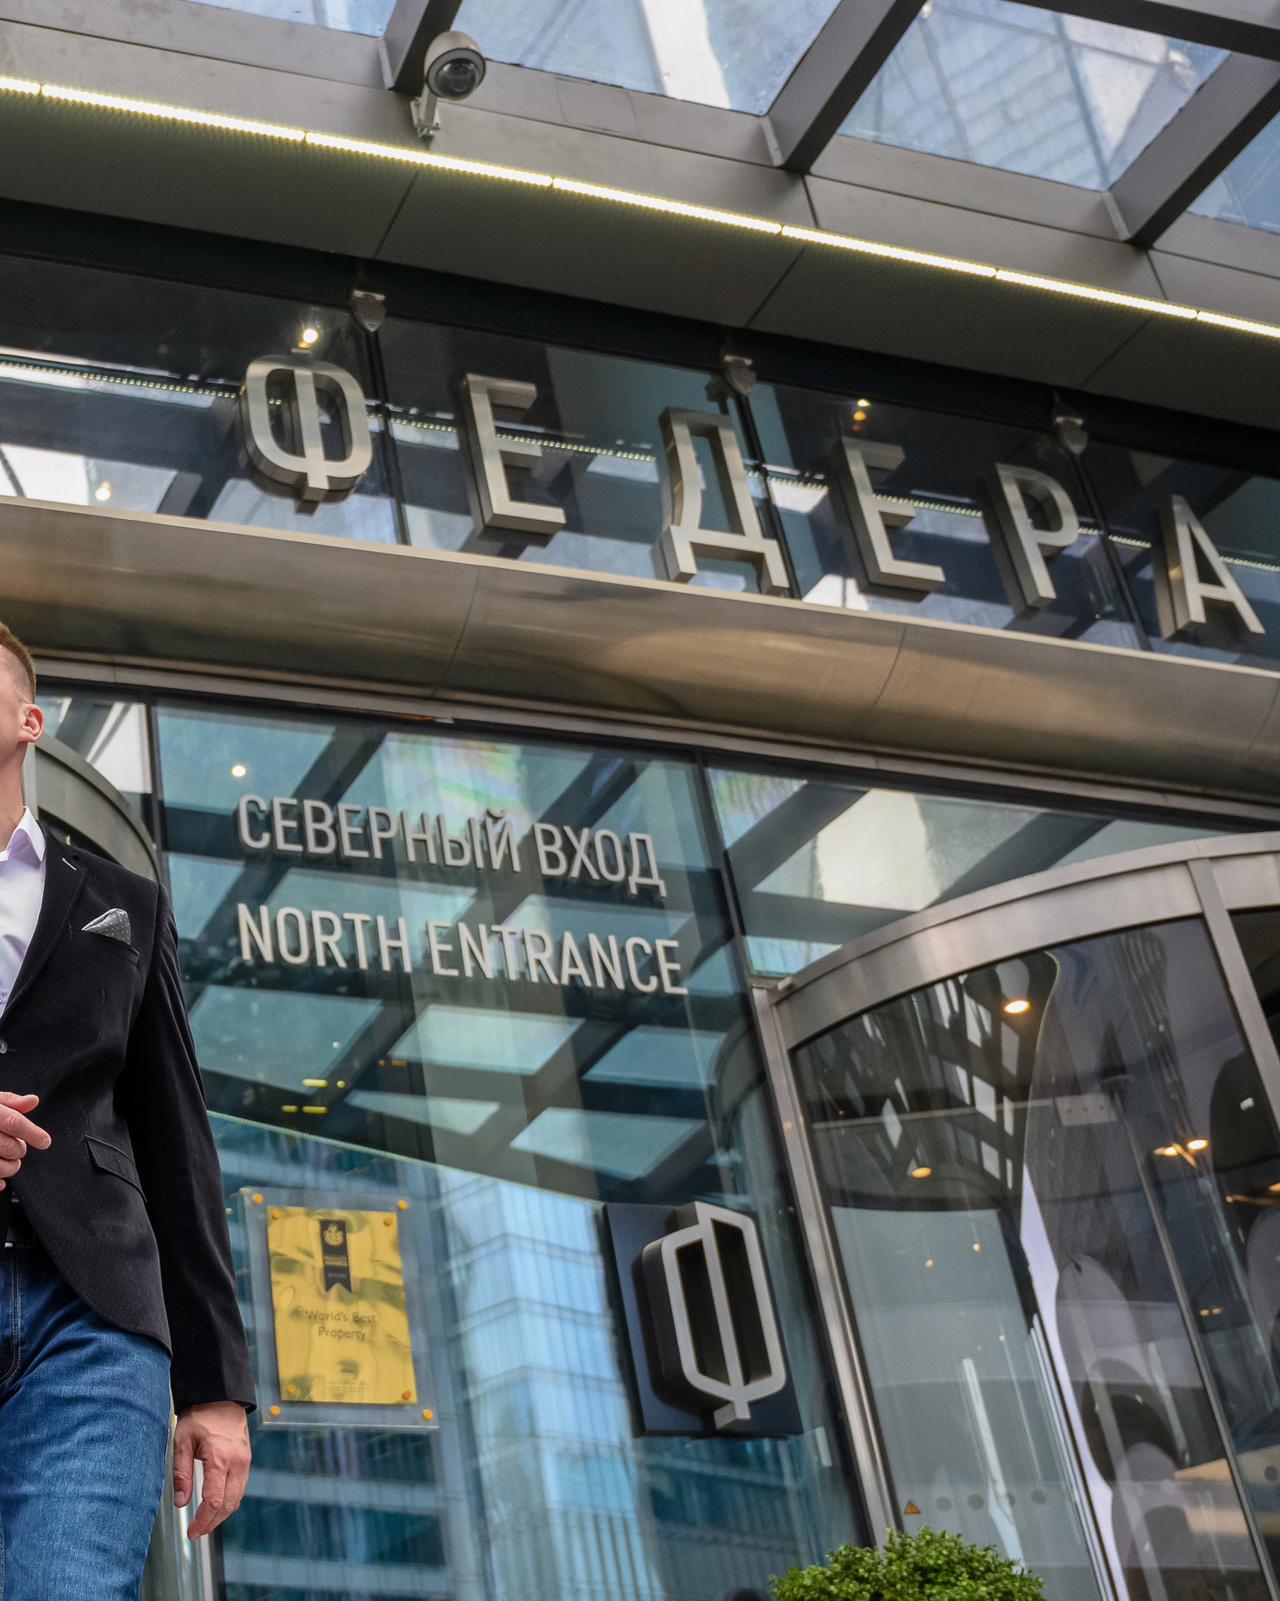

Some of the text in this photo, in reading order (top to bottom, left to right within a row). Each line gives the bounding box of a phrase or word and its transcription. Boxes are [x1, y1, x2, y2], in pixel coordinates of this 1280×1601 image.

[238, 349, 1266, 641] ФЕДЕРА
[236, 794, 667, 898] СЕВЕРНЫЙ ВХОД
[236, 902, 689, 996] NORTH ENTRANCE
[307, 1310, 376, 1323] World's Best
[318, 1326, 366, 1341] Property
